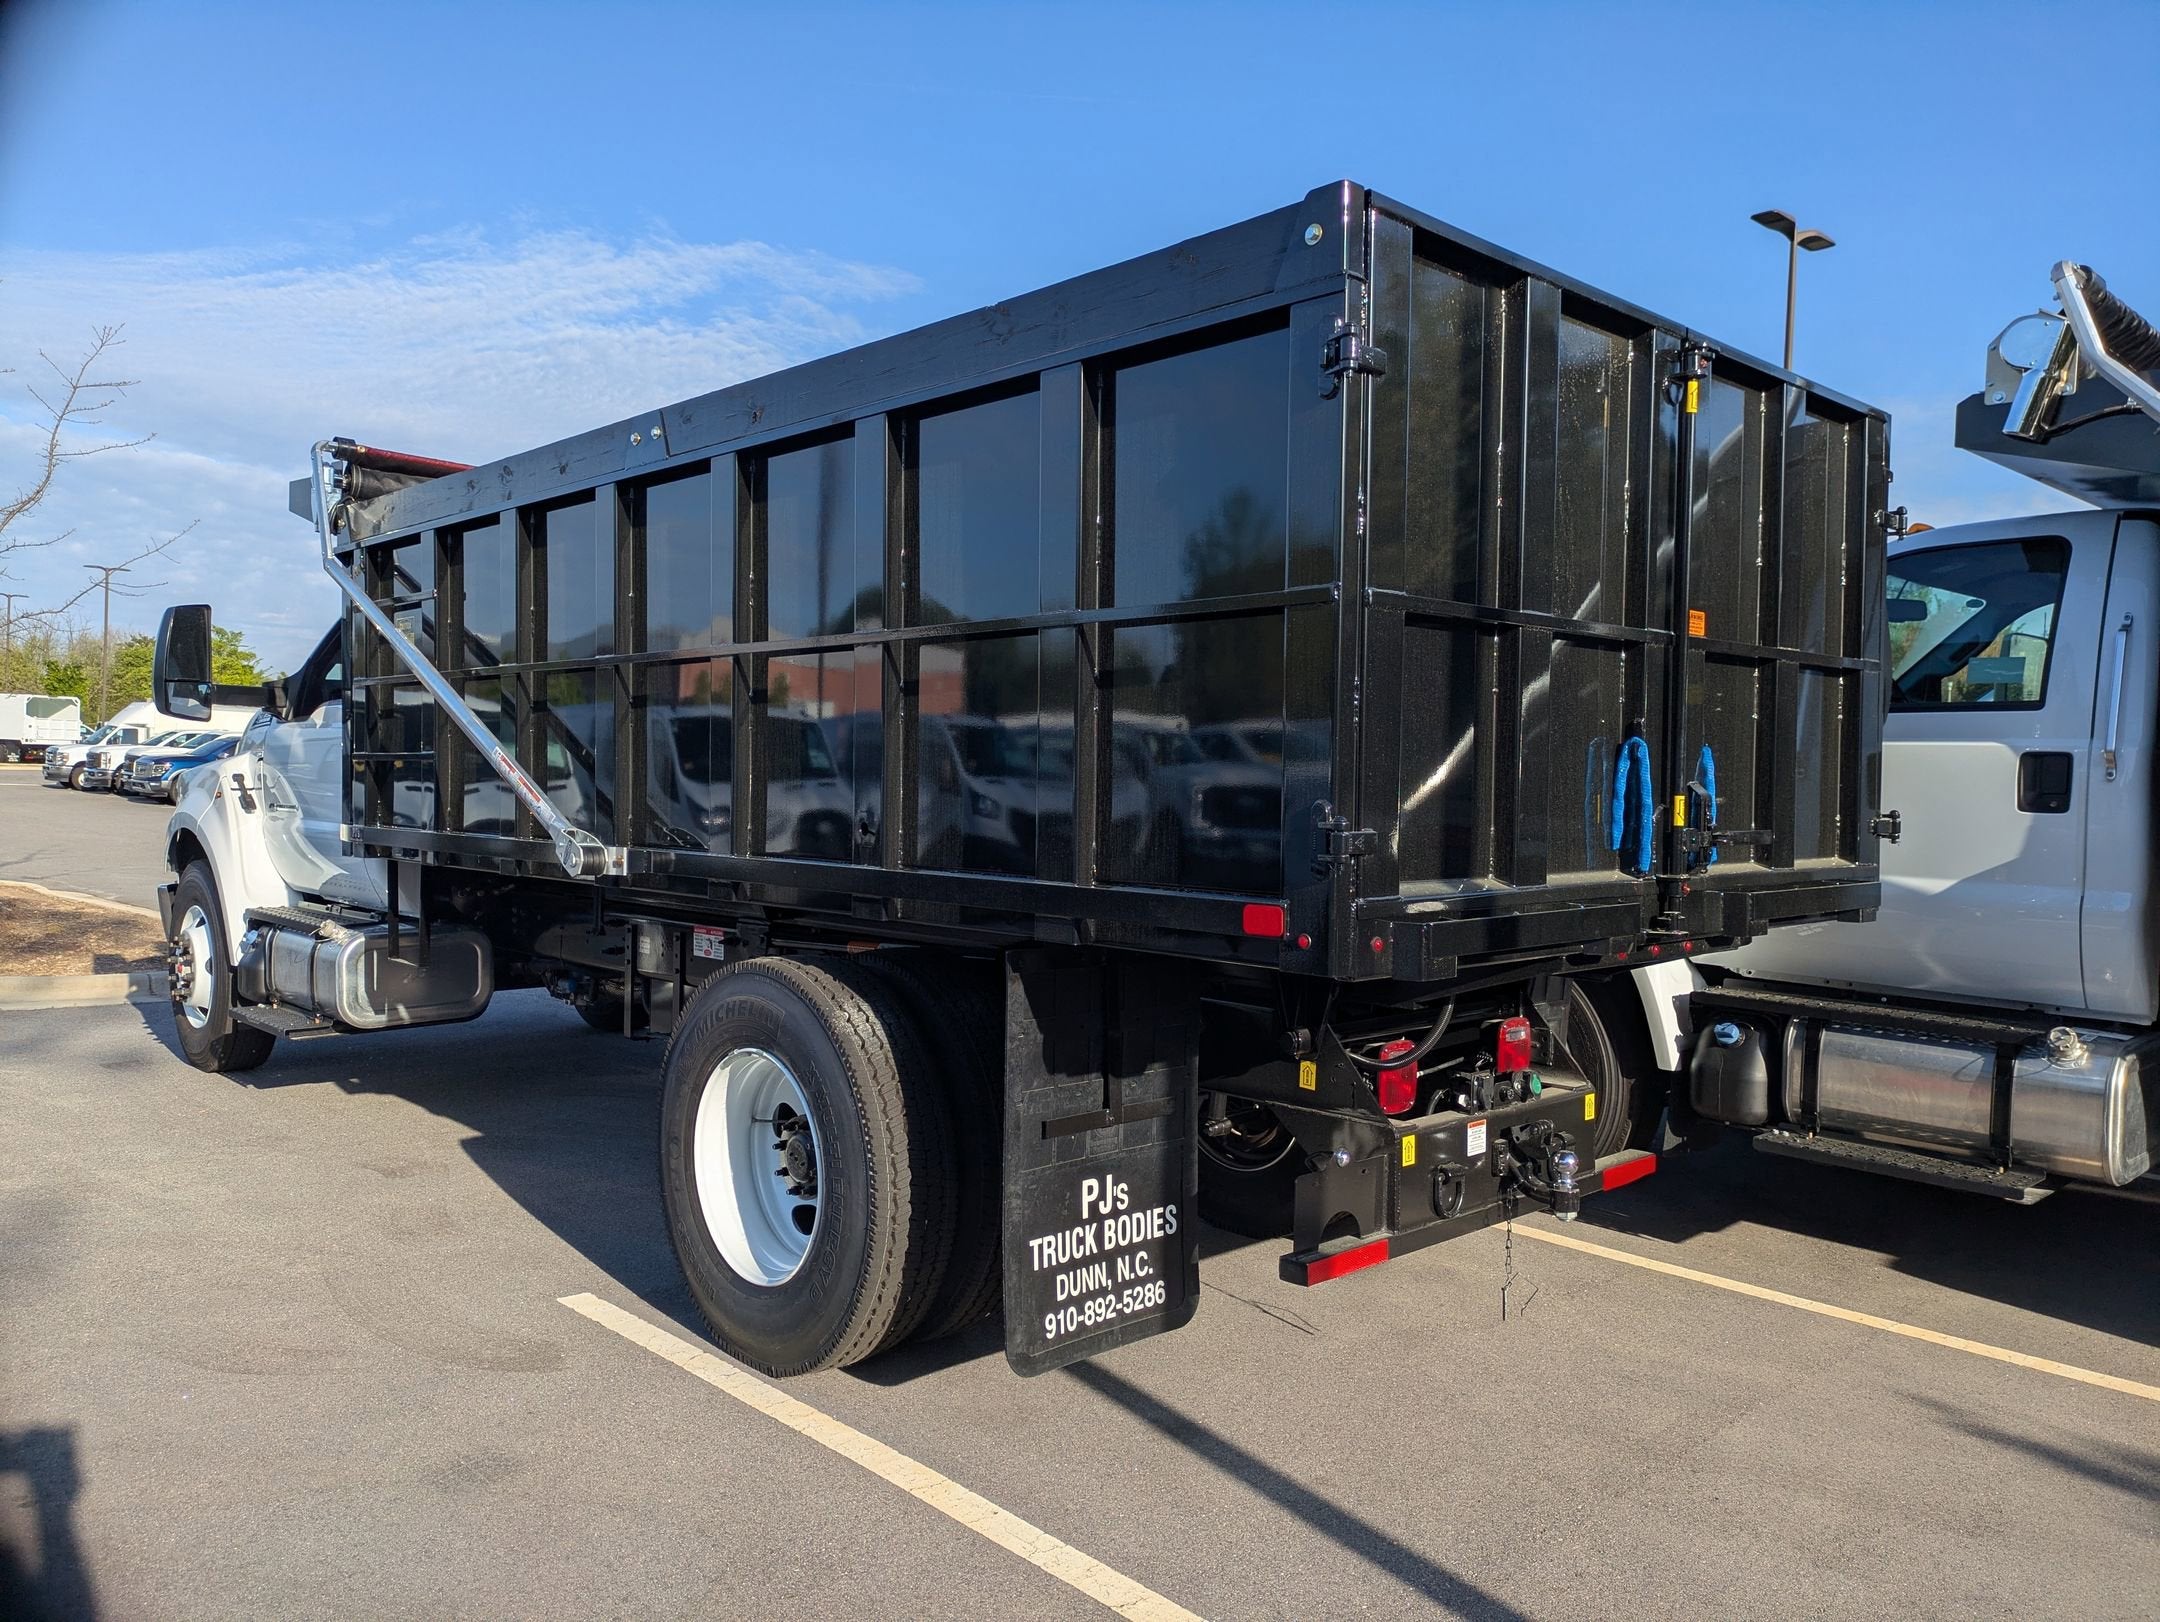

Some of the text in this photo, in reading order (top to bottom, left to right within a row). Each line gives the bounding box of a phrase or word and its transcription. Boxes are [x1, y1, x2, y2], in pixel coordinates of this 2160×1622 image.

[694, 999, 781, 1042] MICHELIN
[818, 1176, 844, 1288] ENERGY
[1029, 1204, 1177, 1272] TRUCK BODIES
[1056, 1250, 1153, 1302] DUNN, N.C.
[1044, 1280, 1166, 1340] 910-892-5286
